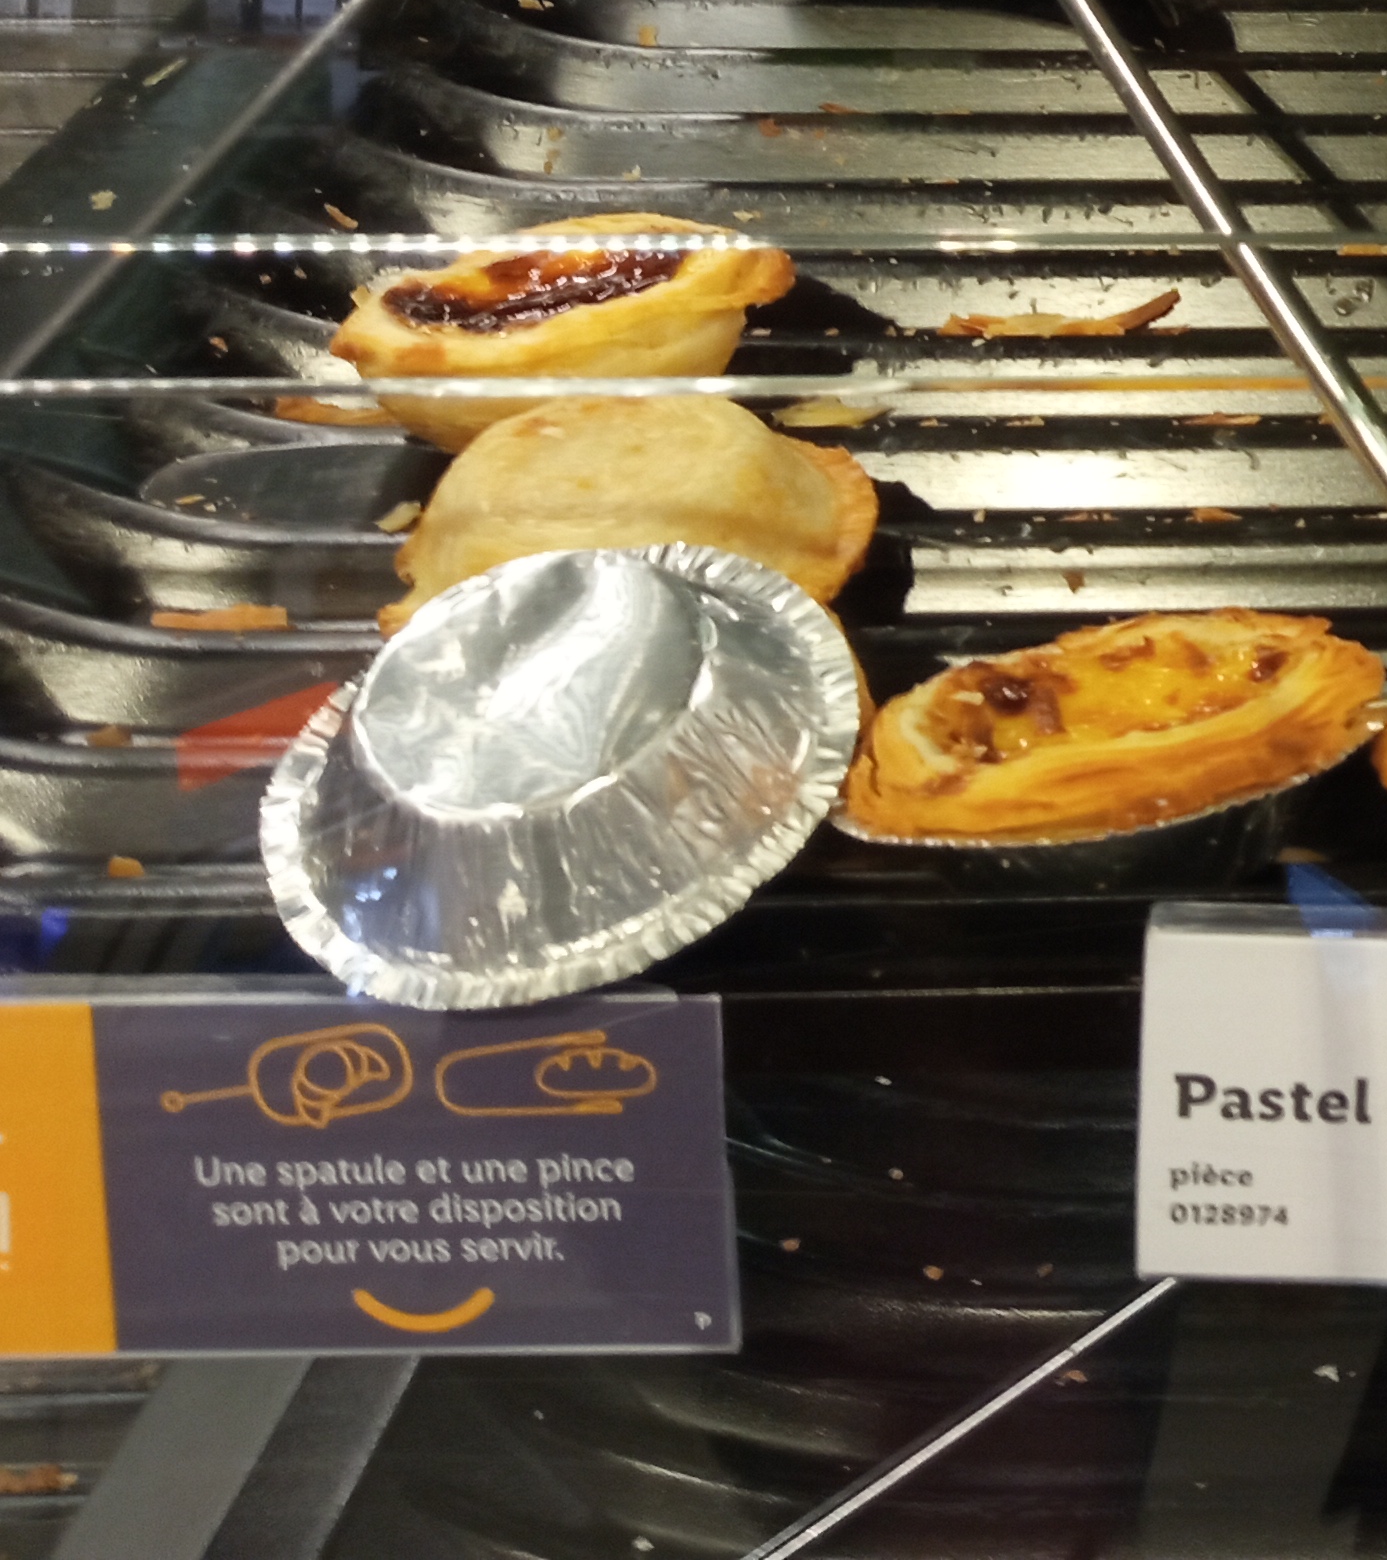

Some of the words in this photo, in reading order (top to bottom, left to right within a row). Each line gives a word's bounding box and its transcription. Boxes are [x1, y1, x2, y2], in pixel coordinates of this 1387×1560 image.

[1174, 1073, 1372, 1124] Pastel
[194, 1155, 267, 1188] Une
[276, 1153, 406, 1189] spatule
[415, 1157, 452, 1184] et
[461, 1159, 528, 1184] une
[538, 1153, 636, 1189] pince
[1169, 1162, 1254, 1190] pièce
[211, 1198, 290, 1226] sont
[299, 1194, 321, 1226] à
[329, 1197, 420, 1225] votre
[429, 1192, 622, 1228] disposition
[1169, 1203, 1289, 1225] 0128974
[276, 1239, 358, 1271] pour
[368, 1237, 451, 1264] vous
[460, 1231, 565, 1263] servir.
